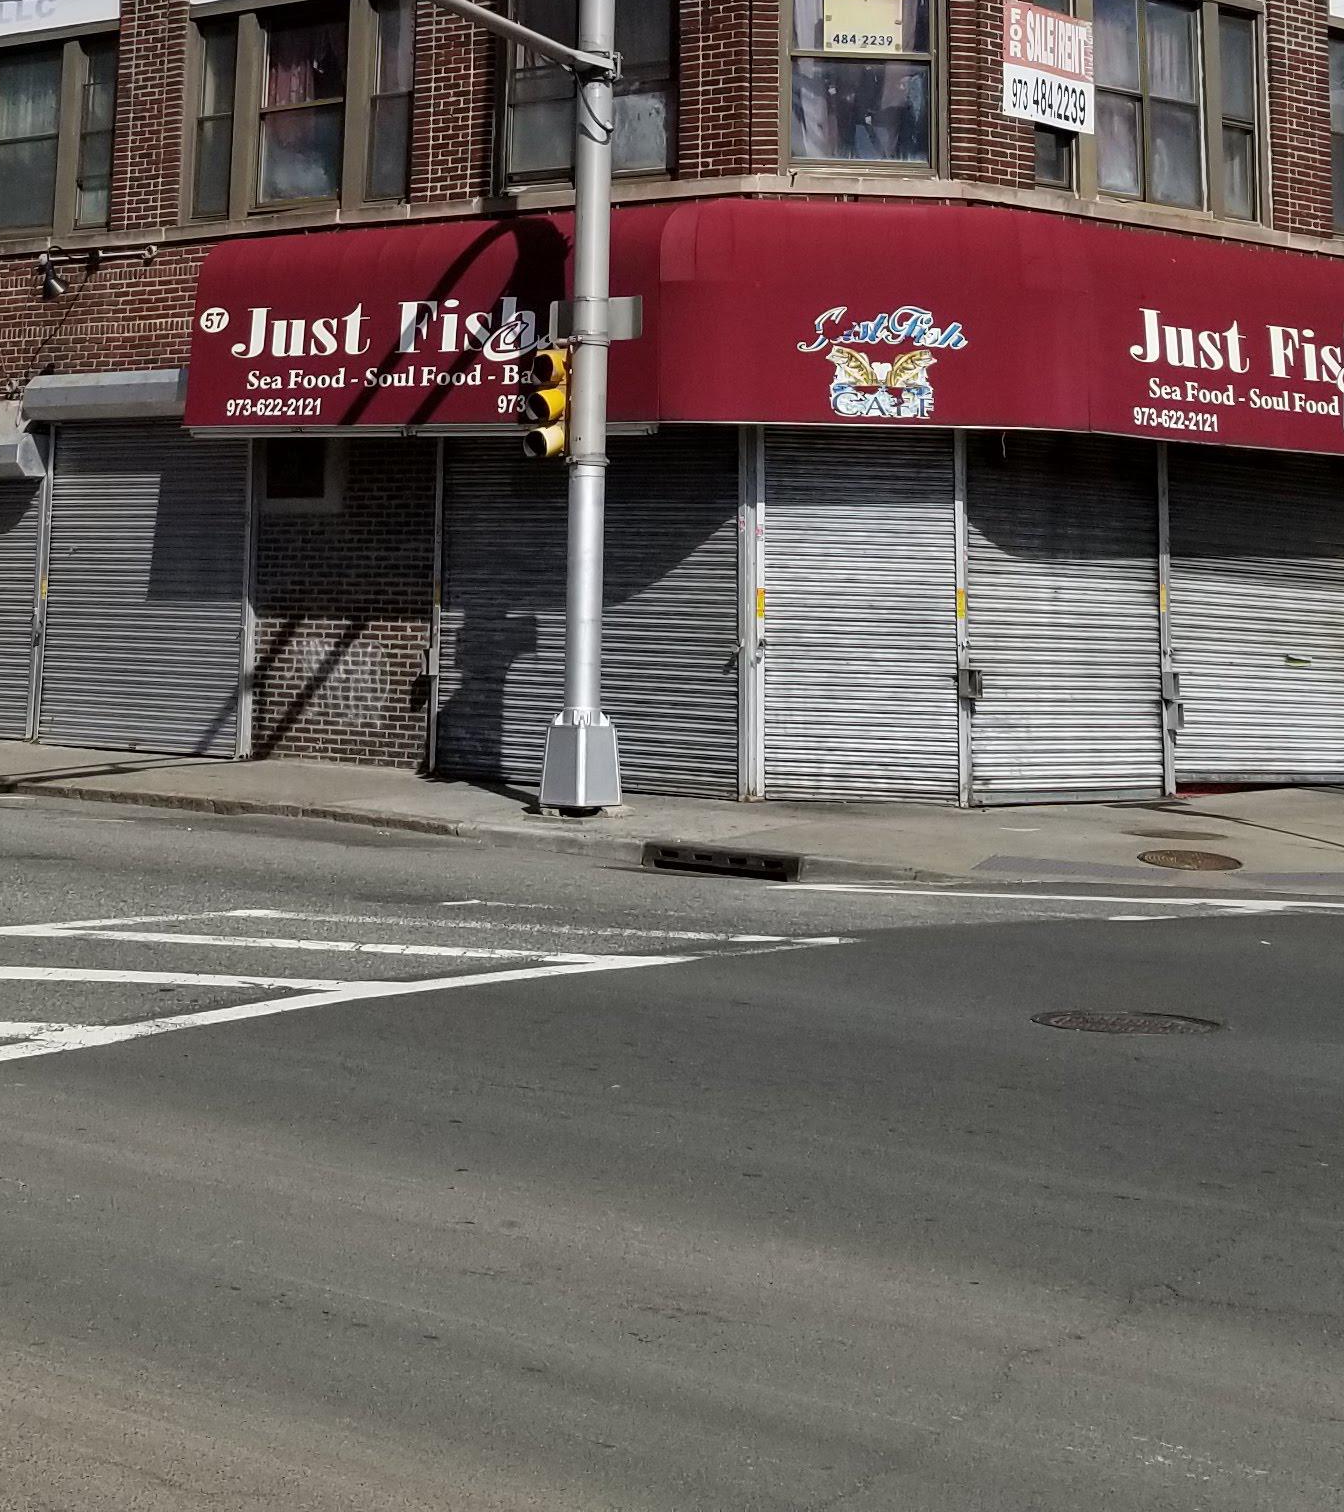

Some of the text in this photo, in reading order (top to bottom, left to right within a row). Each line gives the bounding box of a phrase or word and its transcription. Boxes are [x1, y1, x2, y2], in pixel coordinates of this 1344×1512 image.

[1009, 8, 1023, 57] FOR
[1012, 78, 1028, 110] 973
[204, 312, 225, 330] 57
[231, 302, 371, 359] Just
[1129, 307, 1344, 384] Just Fis
[246, 370, 283, 390] Sea
[288, 368, 346, 389] Food
[364, 366, 415, 388] Soul
[421, 364, 481, 386] Food
[226, 398, 322, 417] 973-622-2121
[1148, 378, 1181, 401] Sea
[1185, 381, 1235, 406] Food
[1249, 389, 1289, 411] Soul
[1294, 392, 1340, 416] Food
[1133, 406, 1218, 432] 973-622-2121
